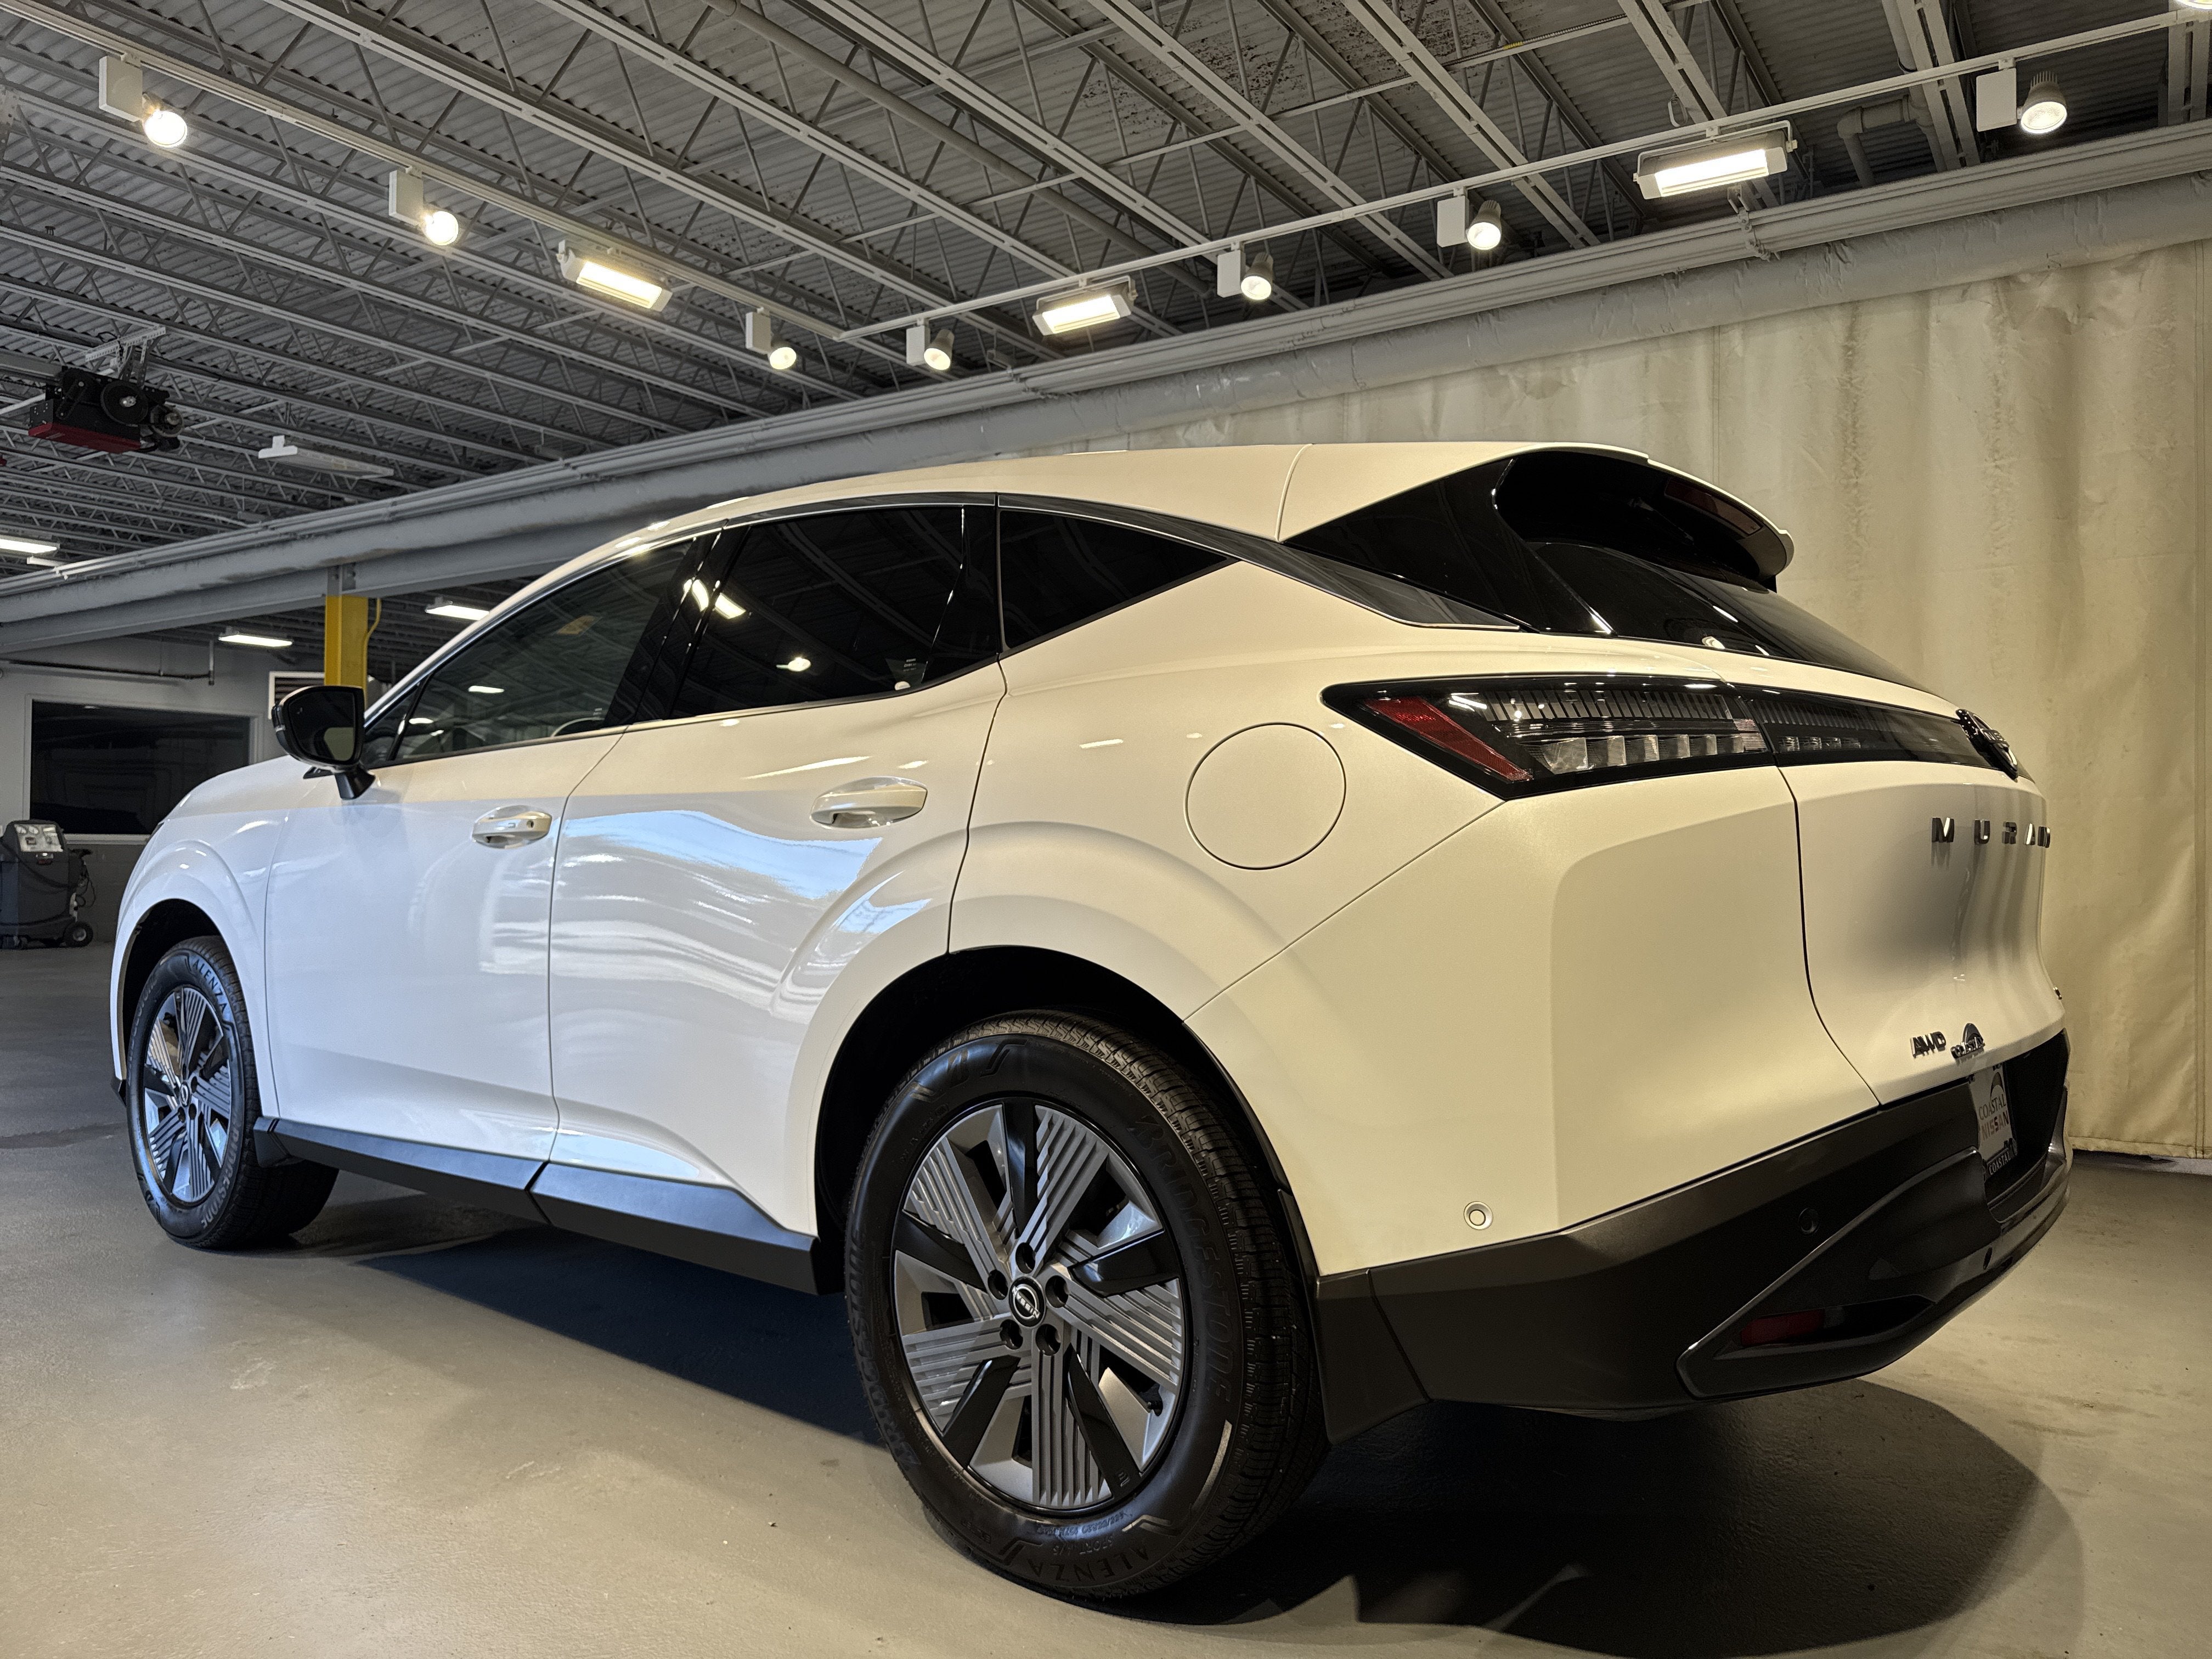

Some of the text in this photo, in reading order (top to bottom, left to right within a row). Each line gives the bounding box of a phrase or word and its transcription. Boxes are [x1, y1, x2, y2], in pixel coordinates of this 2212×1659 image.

[193, 956, 228, 1014] ALENZA
[1910, 1031, 1946, 1057] AWD
[1978, 1093, 2006, 1120] COASTAL
[1981, 1110, 2009, 1141] NISSAN
[1989, 1151, 2011, 1175] COASTAL
[1125, 1113, 1232, 1403] BRIDGESTONE
[1012, 1285, 1041, 1319] NISSAN
[1027, 1544, 1149, 1583] ALENZA
